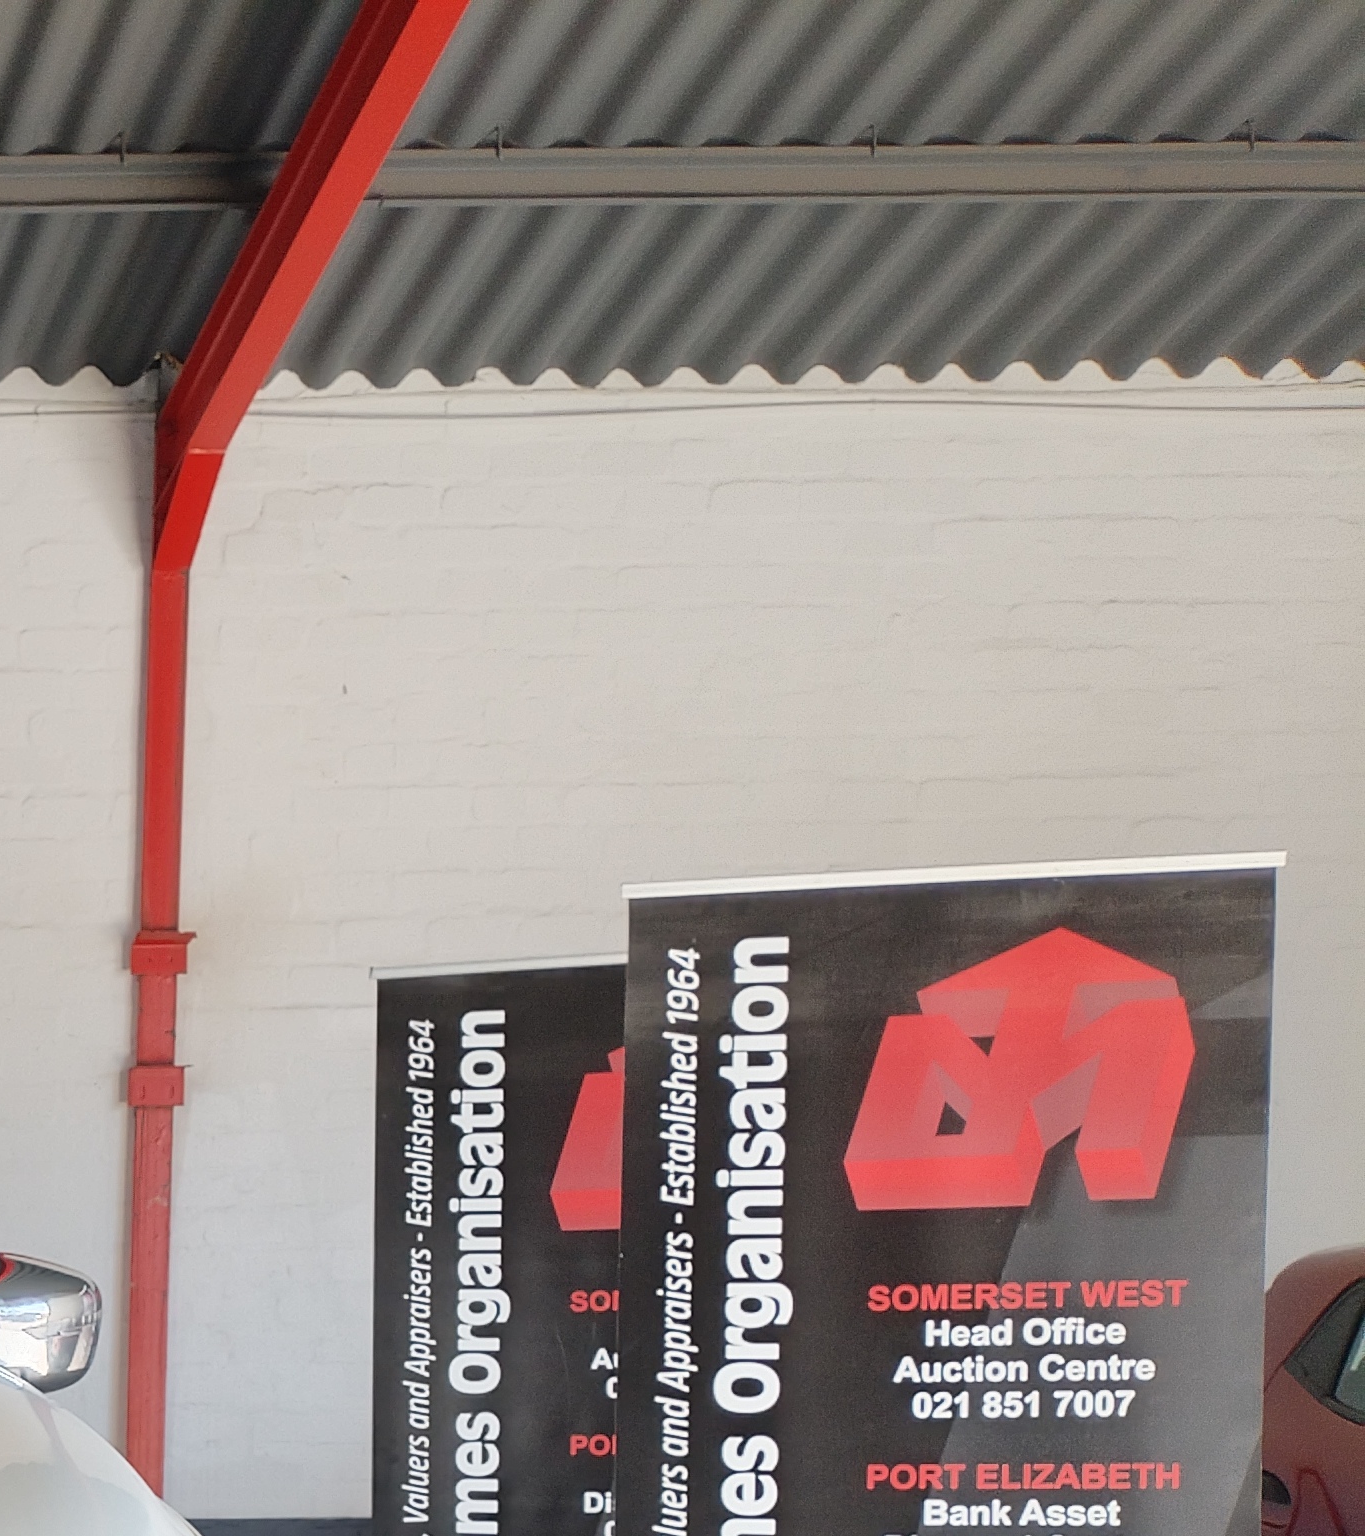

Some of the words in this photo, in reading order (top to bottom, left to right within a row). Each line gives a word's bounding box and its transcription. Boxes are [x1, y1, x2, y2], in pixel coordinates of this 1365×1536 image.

[665, 947, 701, 1025] 1964
[407, 1019, 435, 1081] 1964
[659, 1031, 698, 1206] Established
[403, 1086, 434, 1228] Established
[712, 936, 794, 1414] Organisation
[447, 1009, 511, 1395] Organisation
[402, 1247, 437, 1378] Appraisers
[655, 1231, 700, 1393] Appraisers
[867, 1281, 1072, 1313] SOMERSET
[1080, 1279, 1189, 1308] WEST
[924, 1317, 1014, 1348] Head
[1022, 1316, 1127, 1346] Office
[892, 1354, 1029, 1384] Auction
[1038, 1353, 1157, 1383] Centre
[401, 1379, 430, 1430] and
[653, 1395, 690, 1457] and
[911, 1390, 970, 1420] 021
[981, 1389, 1040, 1419] 851
[1052, 1389, 1137, 1418] 7007
[401, 1434, 430, 1524] Valuers
[866, 1462, 966, 1492] PORT
[975, 1462, 1181, 1491] ELIZABETH
[923, 1498, 1013, 1527] Bank
[1018, 1498, 1122, 1527] Asset
